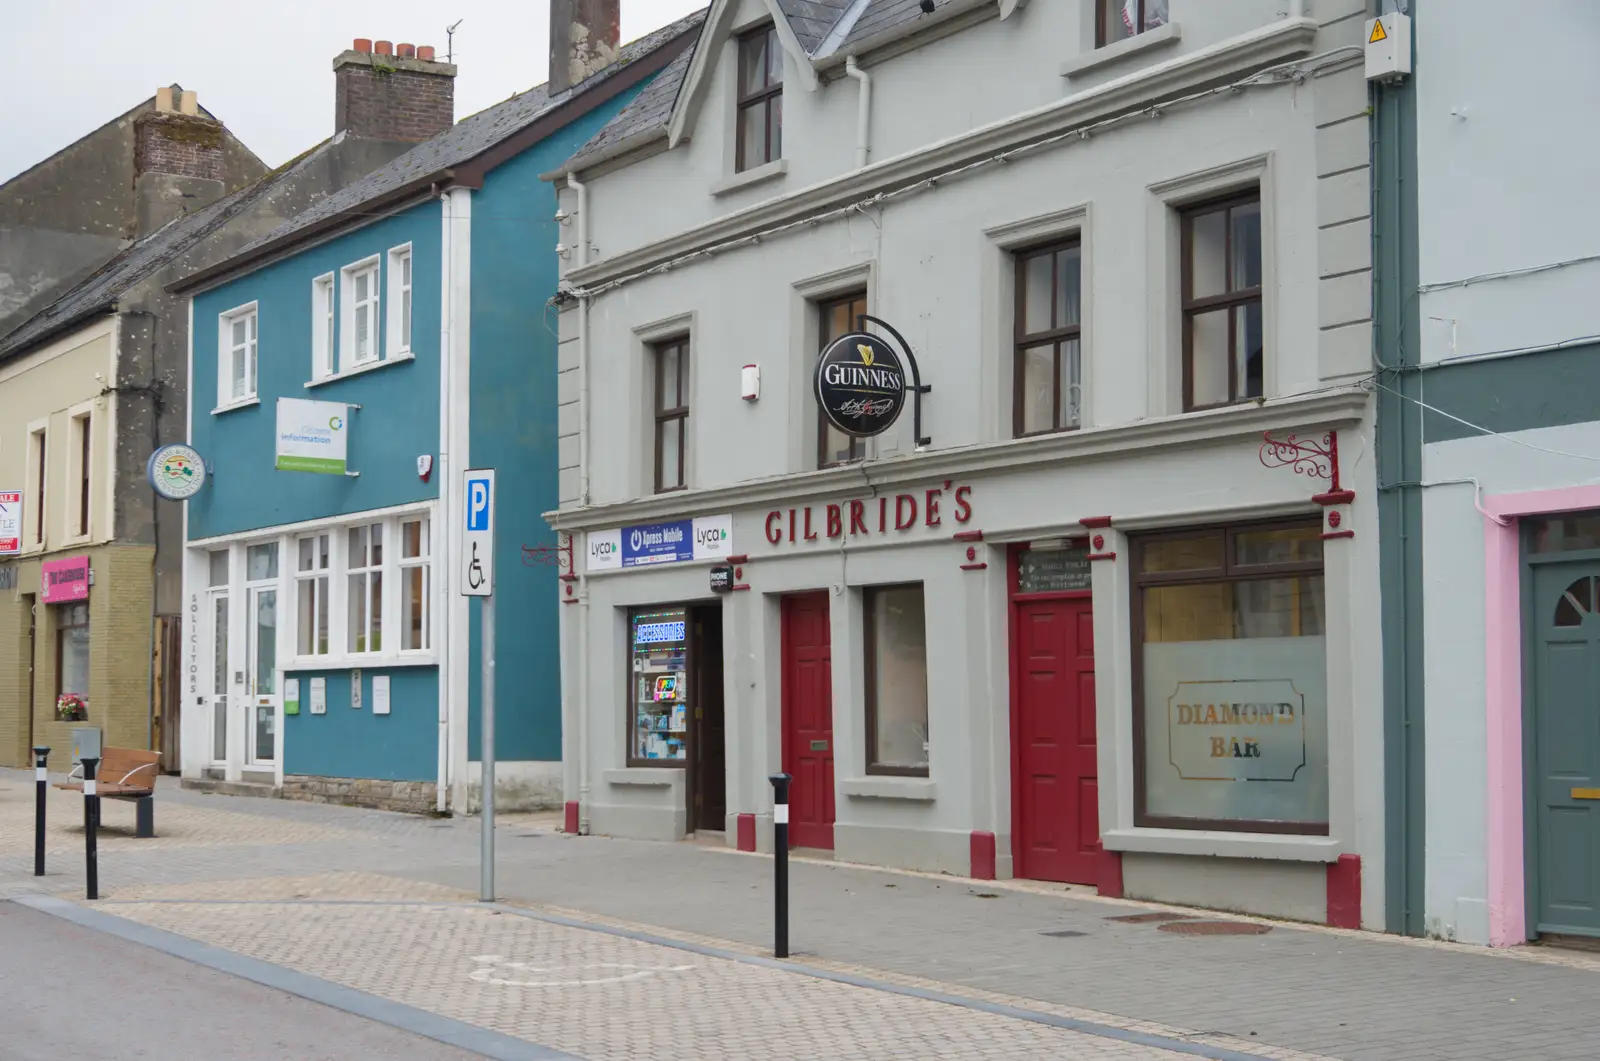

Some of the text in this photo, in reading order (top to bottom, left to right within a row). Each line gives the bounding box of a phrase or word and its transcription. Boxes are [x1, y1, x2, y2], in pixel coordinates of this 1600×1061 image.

[825, 364, 900, 390] GUINNESS
[156, 450, 173, 468] HOME
[471, 482, 487, 528] P
[765, 480, 972, 545] GILBRIDE'S
[642, 527, 683, 548] Xpress Mobile
[697, 528, 720, 545] Lyca
[591, 541, 611, 556] Lyca
[710, 572, 728, 581] PHONE
[637, 622, 685, 642] ACCESSORIES
[190, 594, 198, 693] SOLICITORS
[657, 679, 675, 689] OPEN
[1176, 702, 1295, 725] DIAMOND
[1209, 736, 1261, 758] BAR
